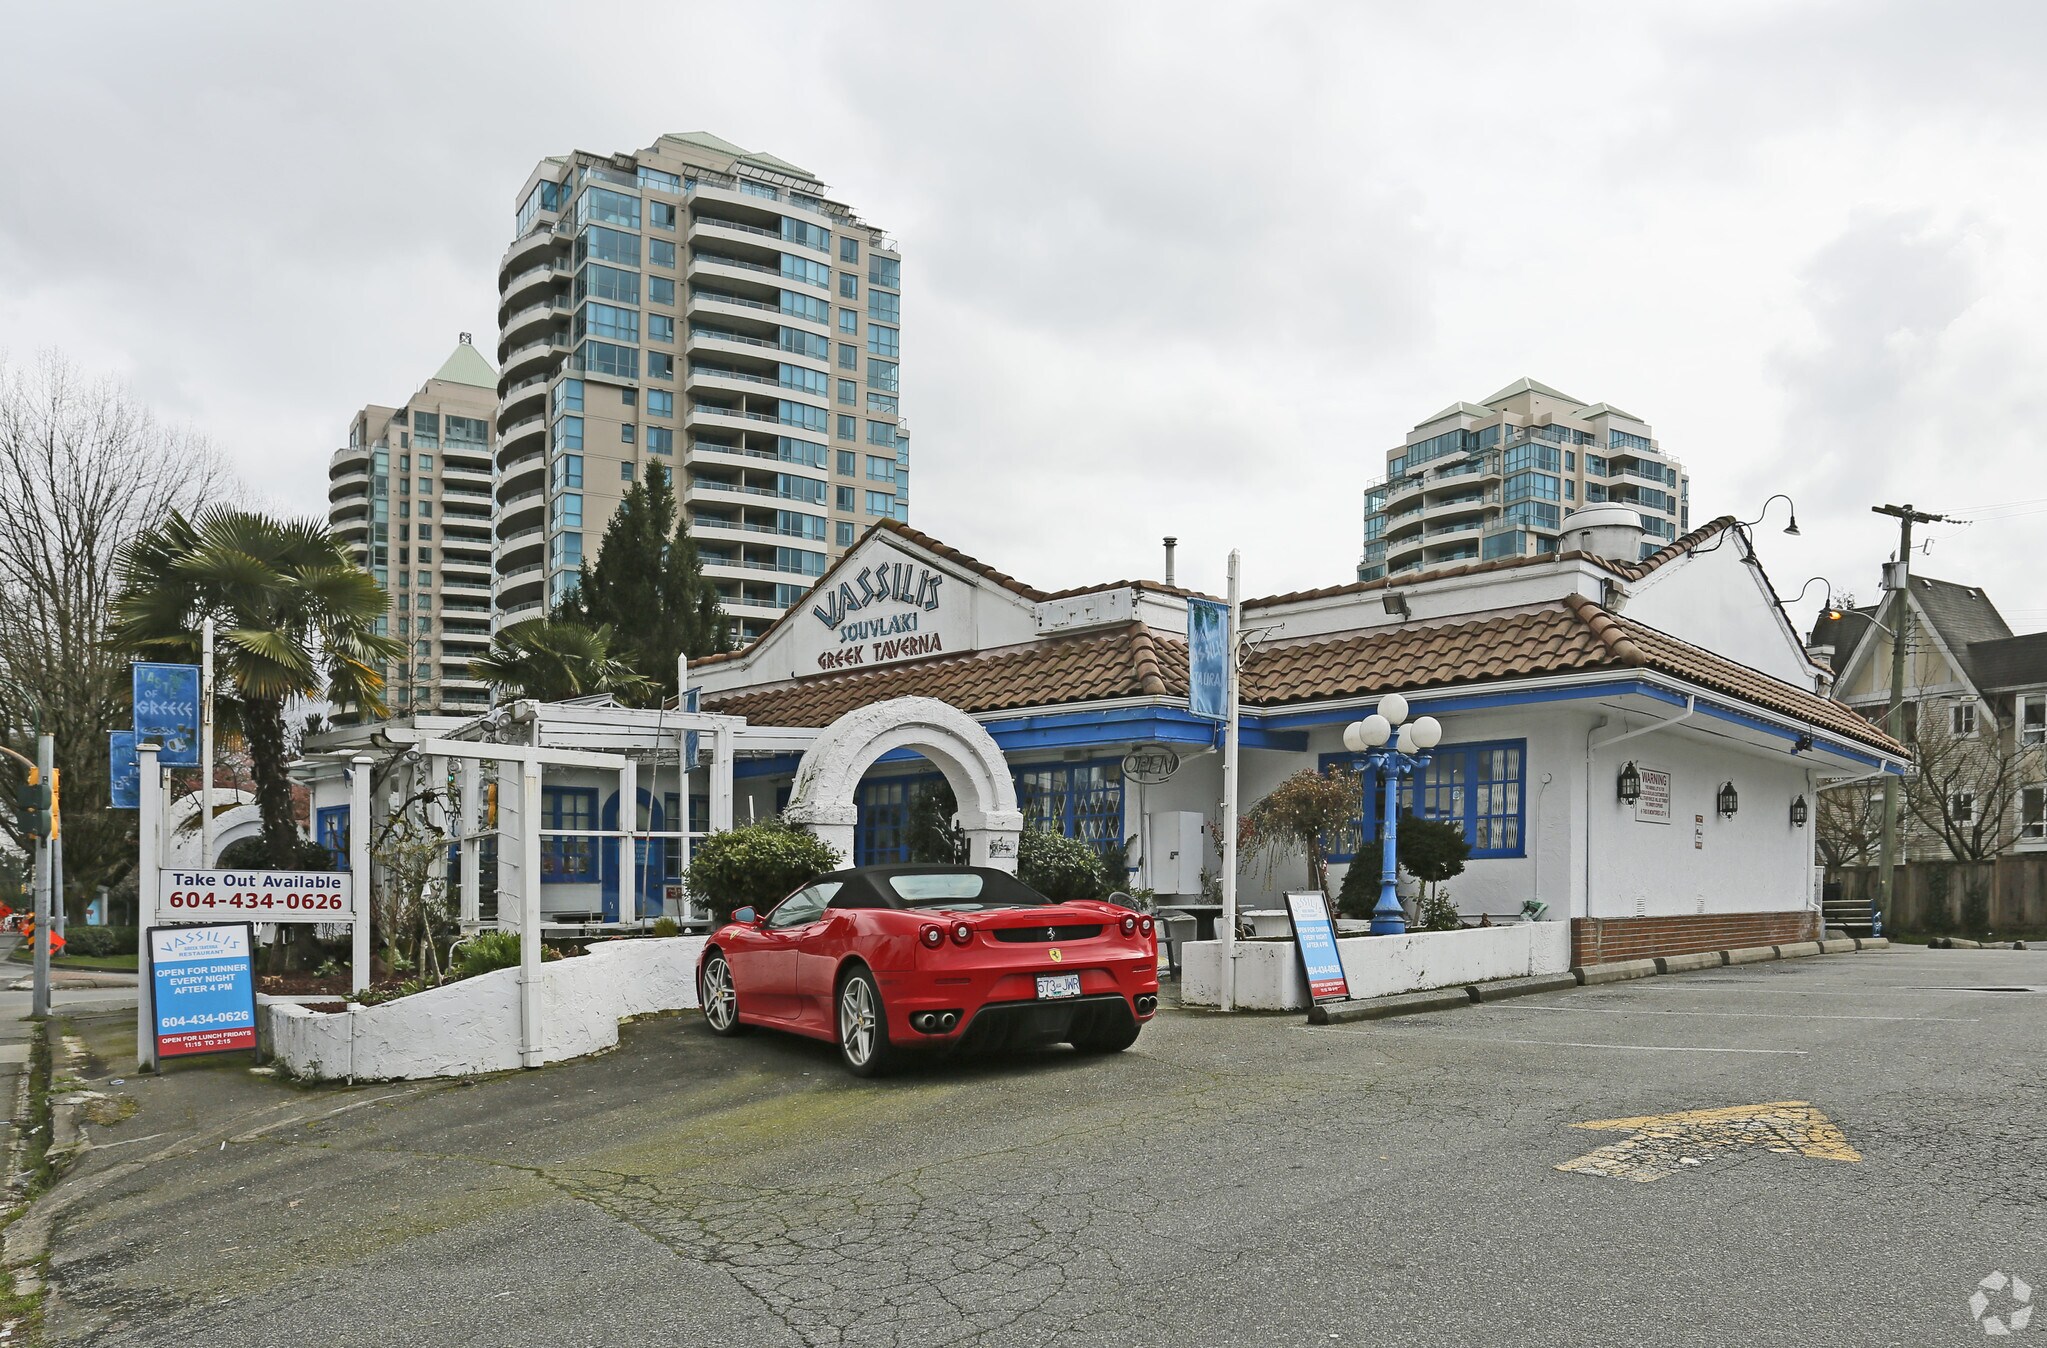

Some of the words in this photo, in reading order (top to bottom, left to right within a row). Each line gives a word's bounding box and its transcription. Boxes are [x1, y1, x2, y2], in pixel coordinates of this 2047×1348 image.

[811, 562, 943, 631] VASSILIS
[840, 612, 918, 644] SOUVLAKI
[818, 645, 864, 670] GREEK
[873, 632, 943, 661] TAVERNA
[140, 668, 177, 698] TASTE
[145, 690, 159, 698] OF
[136, 701, 193, 717] GREECE
[1124, 754, 1175, 775] OPEN
[1641, 771, 1667, 786] WARNING
[173, 873, 216, 887] Take
[223, 874, 256, 887] Out
[263, 875, 341, 889] Available
[169, 891, 342, 910] 604-434-0626
[160, 930, 240, 952] VASSILIS
[157, 969, 185, 977] OPEN
[188, 967, 208, 975] FOR
[211, 964, 247, 973] DINNER
[170, 977, 203, 986] EVERY
[206, 973, 236, 982] NIGHT
[1038, 980, 1056, 993] 573
[1062, 978, 1079, 990] JWR
[174, 984, 207, 994] AFTER
[218, 983, 233, 991] PM
[162, 1011, 249, 1028] 604-434-0626
[223, 1030, 251, 1038] FRIDAYS
